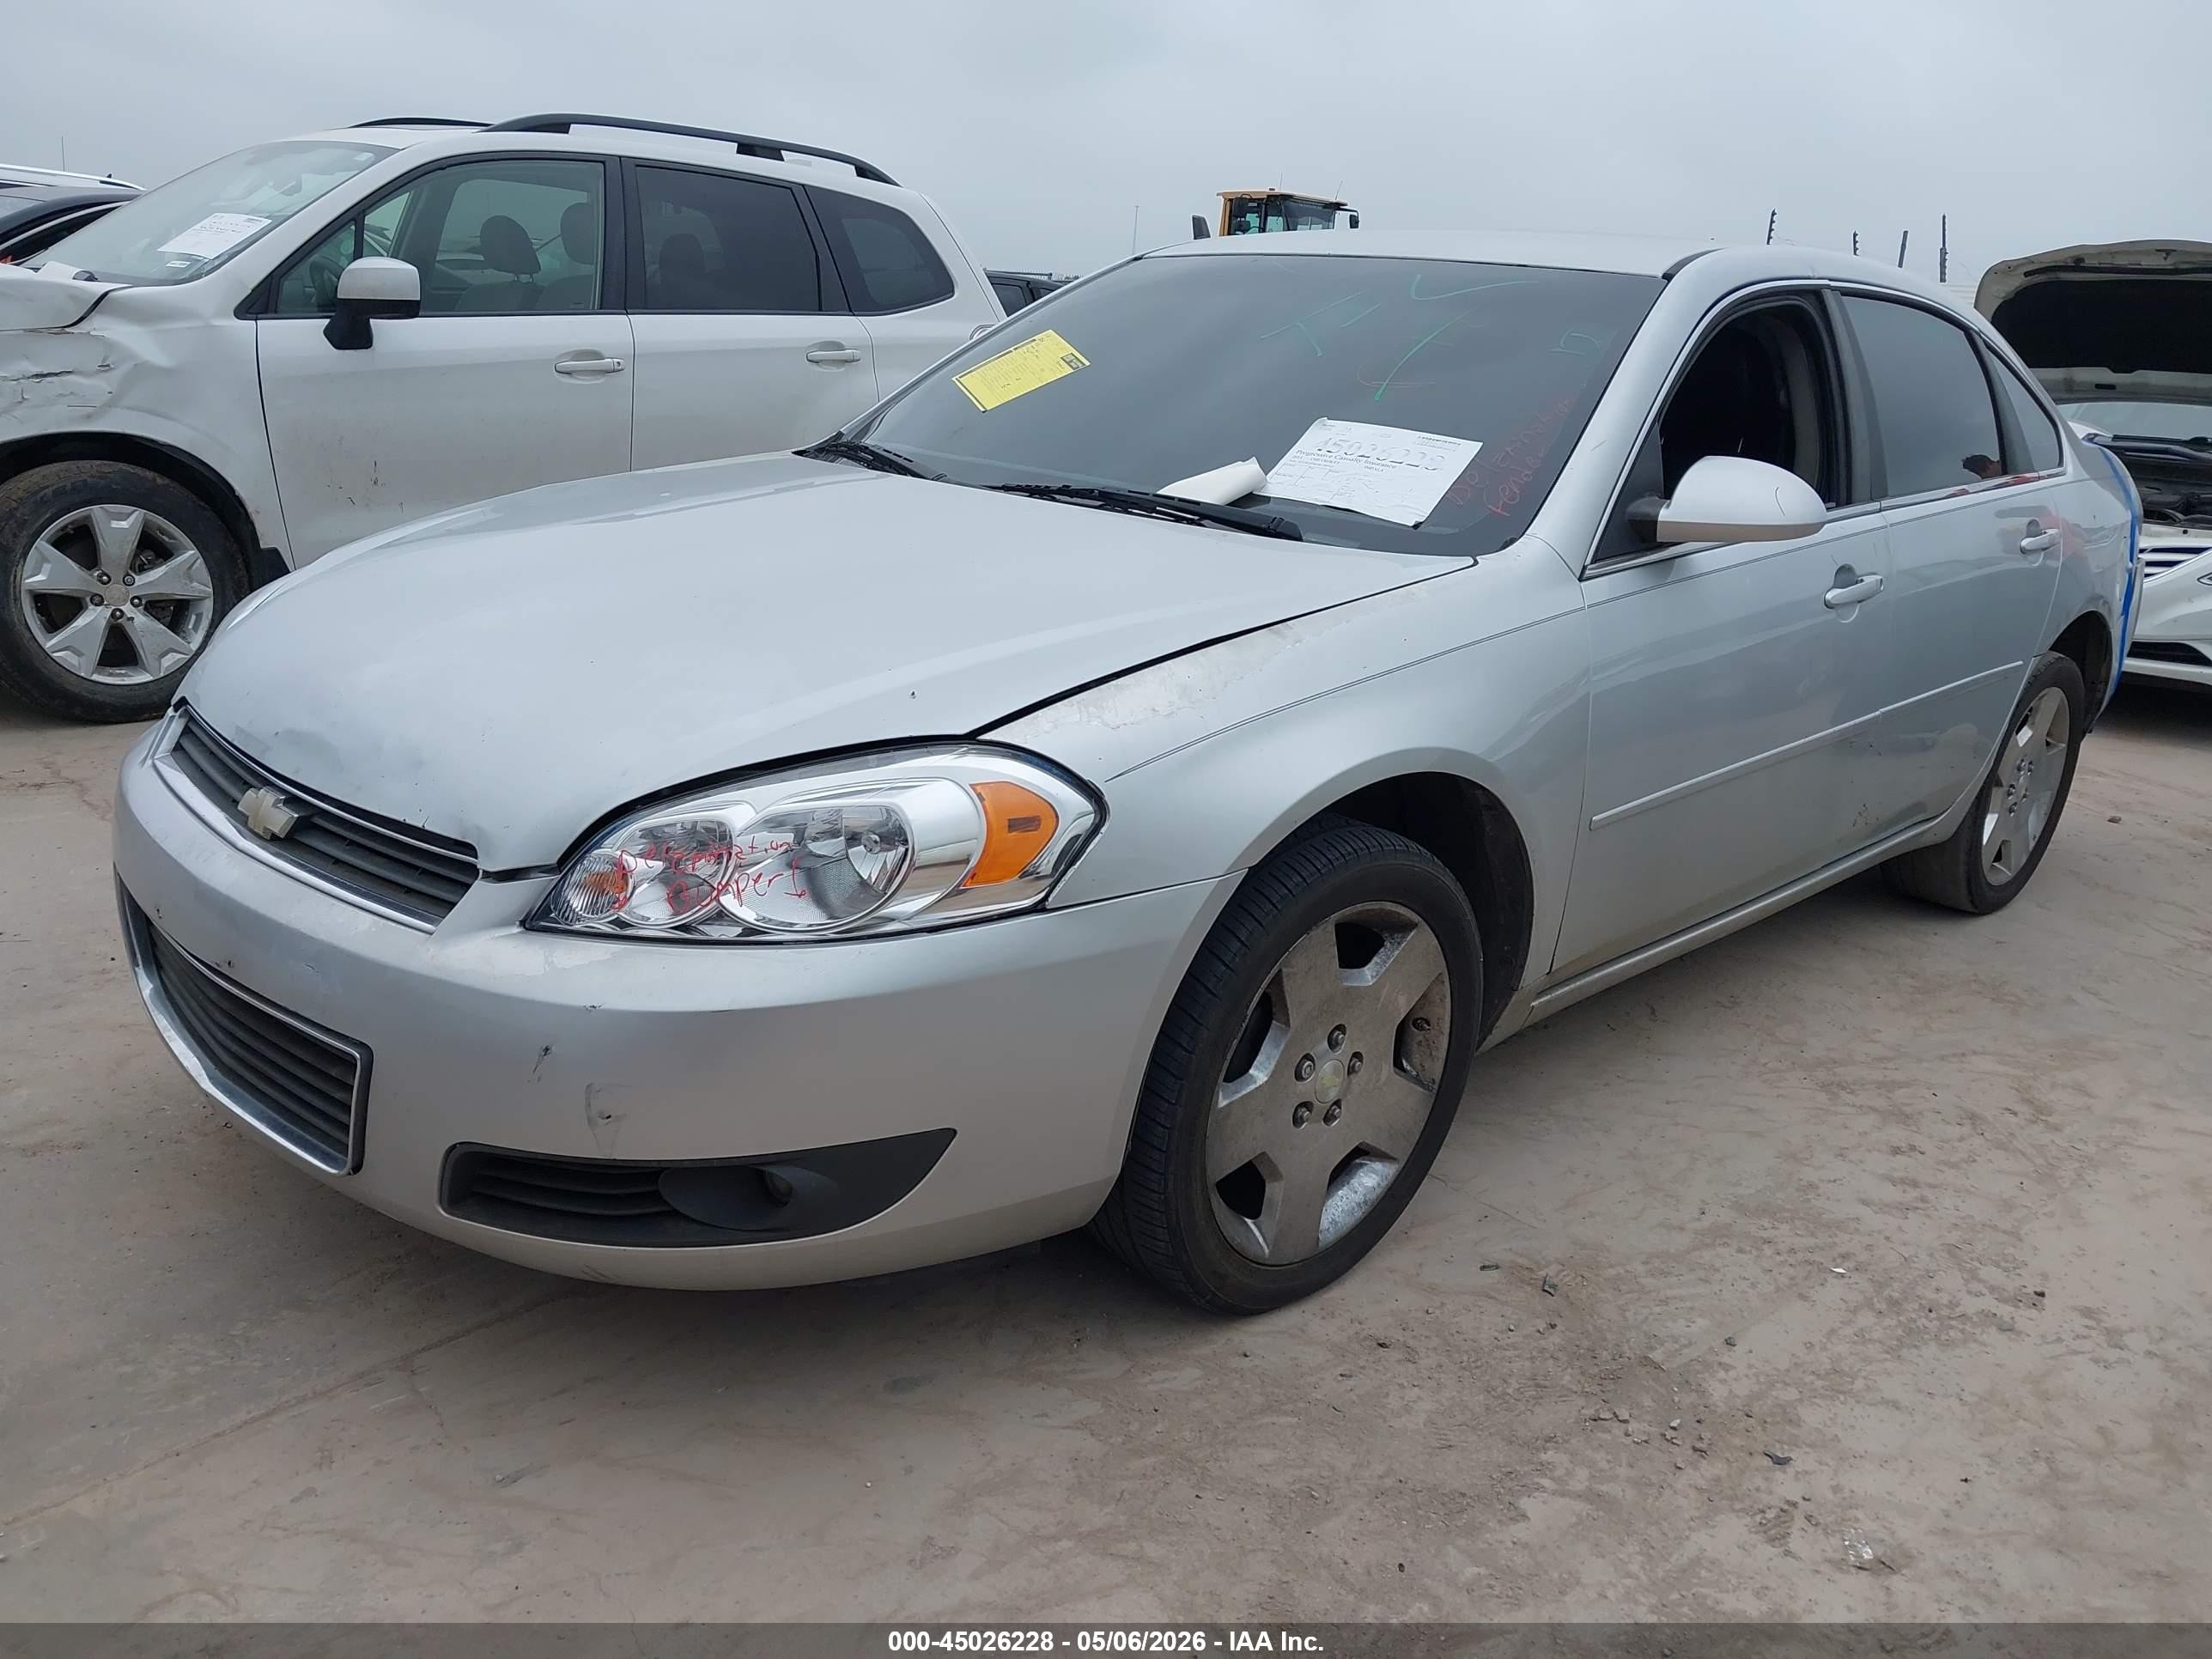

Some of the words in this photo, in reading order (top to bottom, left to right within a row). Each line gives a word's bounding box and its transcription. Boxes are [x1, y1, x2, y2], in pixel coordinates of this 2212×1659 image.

[1296, 449, 1334, 459] Progressive
[1334, 454, 1363, 465] Casualty
[1364, 459, 1397, 469] Insurance
